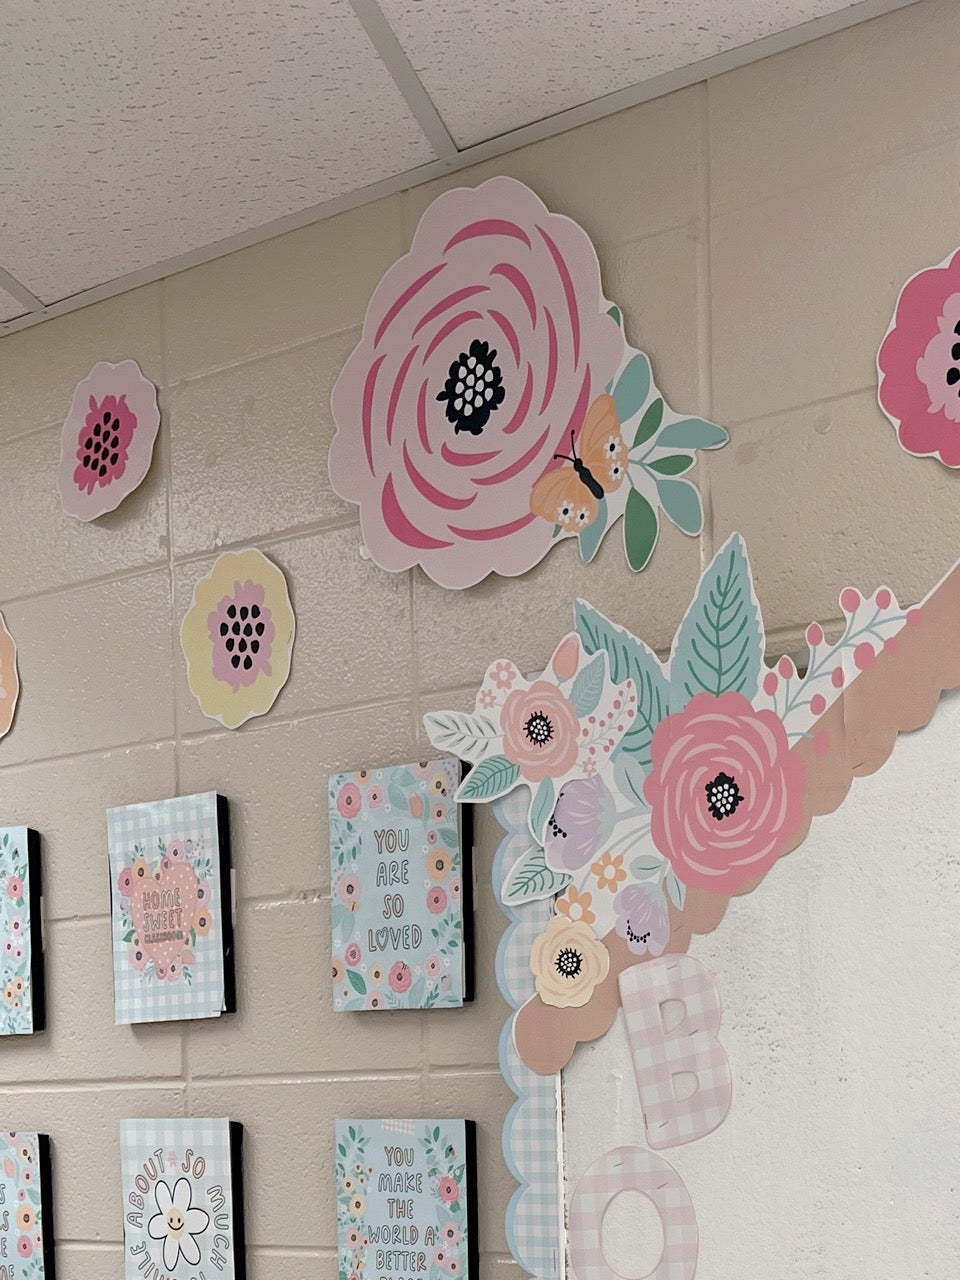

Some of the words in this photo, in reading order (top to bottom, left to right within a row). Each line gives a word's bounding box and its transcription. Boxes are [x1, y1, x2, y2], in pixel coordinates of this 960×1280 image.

[374, 829, 409, 854] YOU
[376, 860, 409, 887] ARE
[143, 888, 181, 911] HOME
[383, 894, 404, 919] SO
[143, 908, 183, 932] SWEET
[182, 1149, 206, 1179] SO
[384, 1146, 414, 1167] YOU
[127, 1148, 165, 1228] ABOUT
[378, 1172, 422, 1193] MAKE
[387, 1199, 414, 1219] THE
[207, 1185, 230, 1271] MUCH
[368, 1225, 418, 1245] WORLD
[424, 1226, 435, 1246] A
[376, 1250, 427, 1272] BETTER
